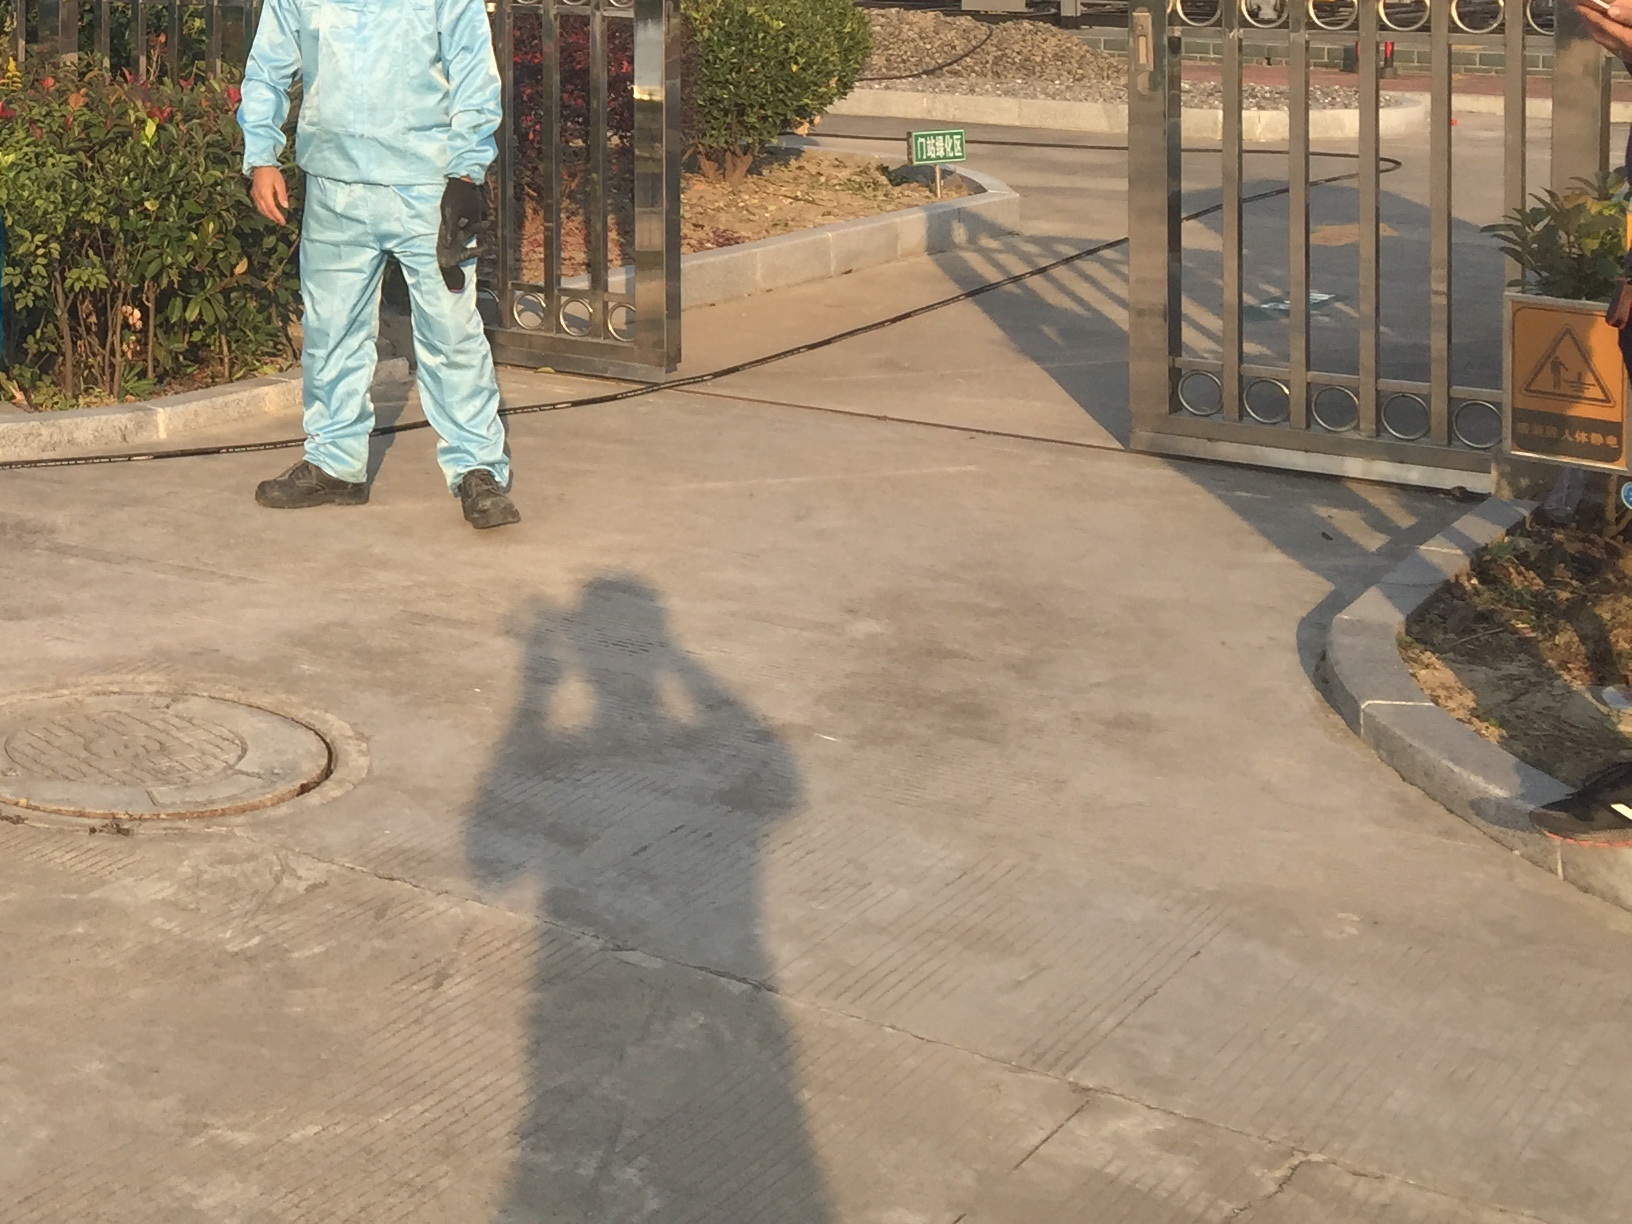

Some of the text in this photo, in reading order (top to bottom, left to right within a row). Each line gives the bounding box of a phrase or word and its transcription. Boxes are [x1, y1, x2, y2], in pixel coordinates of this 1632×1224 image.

[917, 135, 963, 159] 门站绿化区
